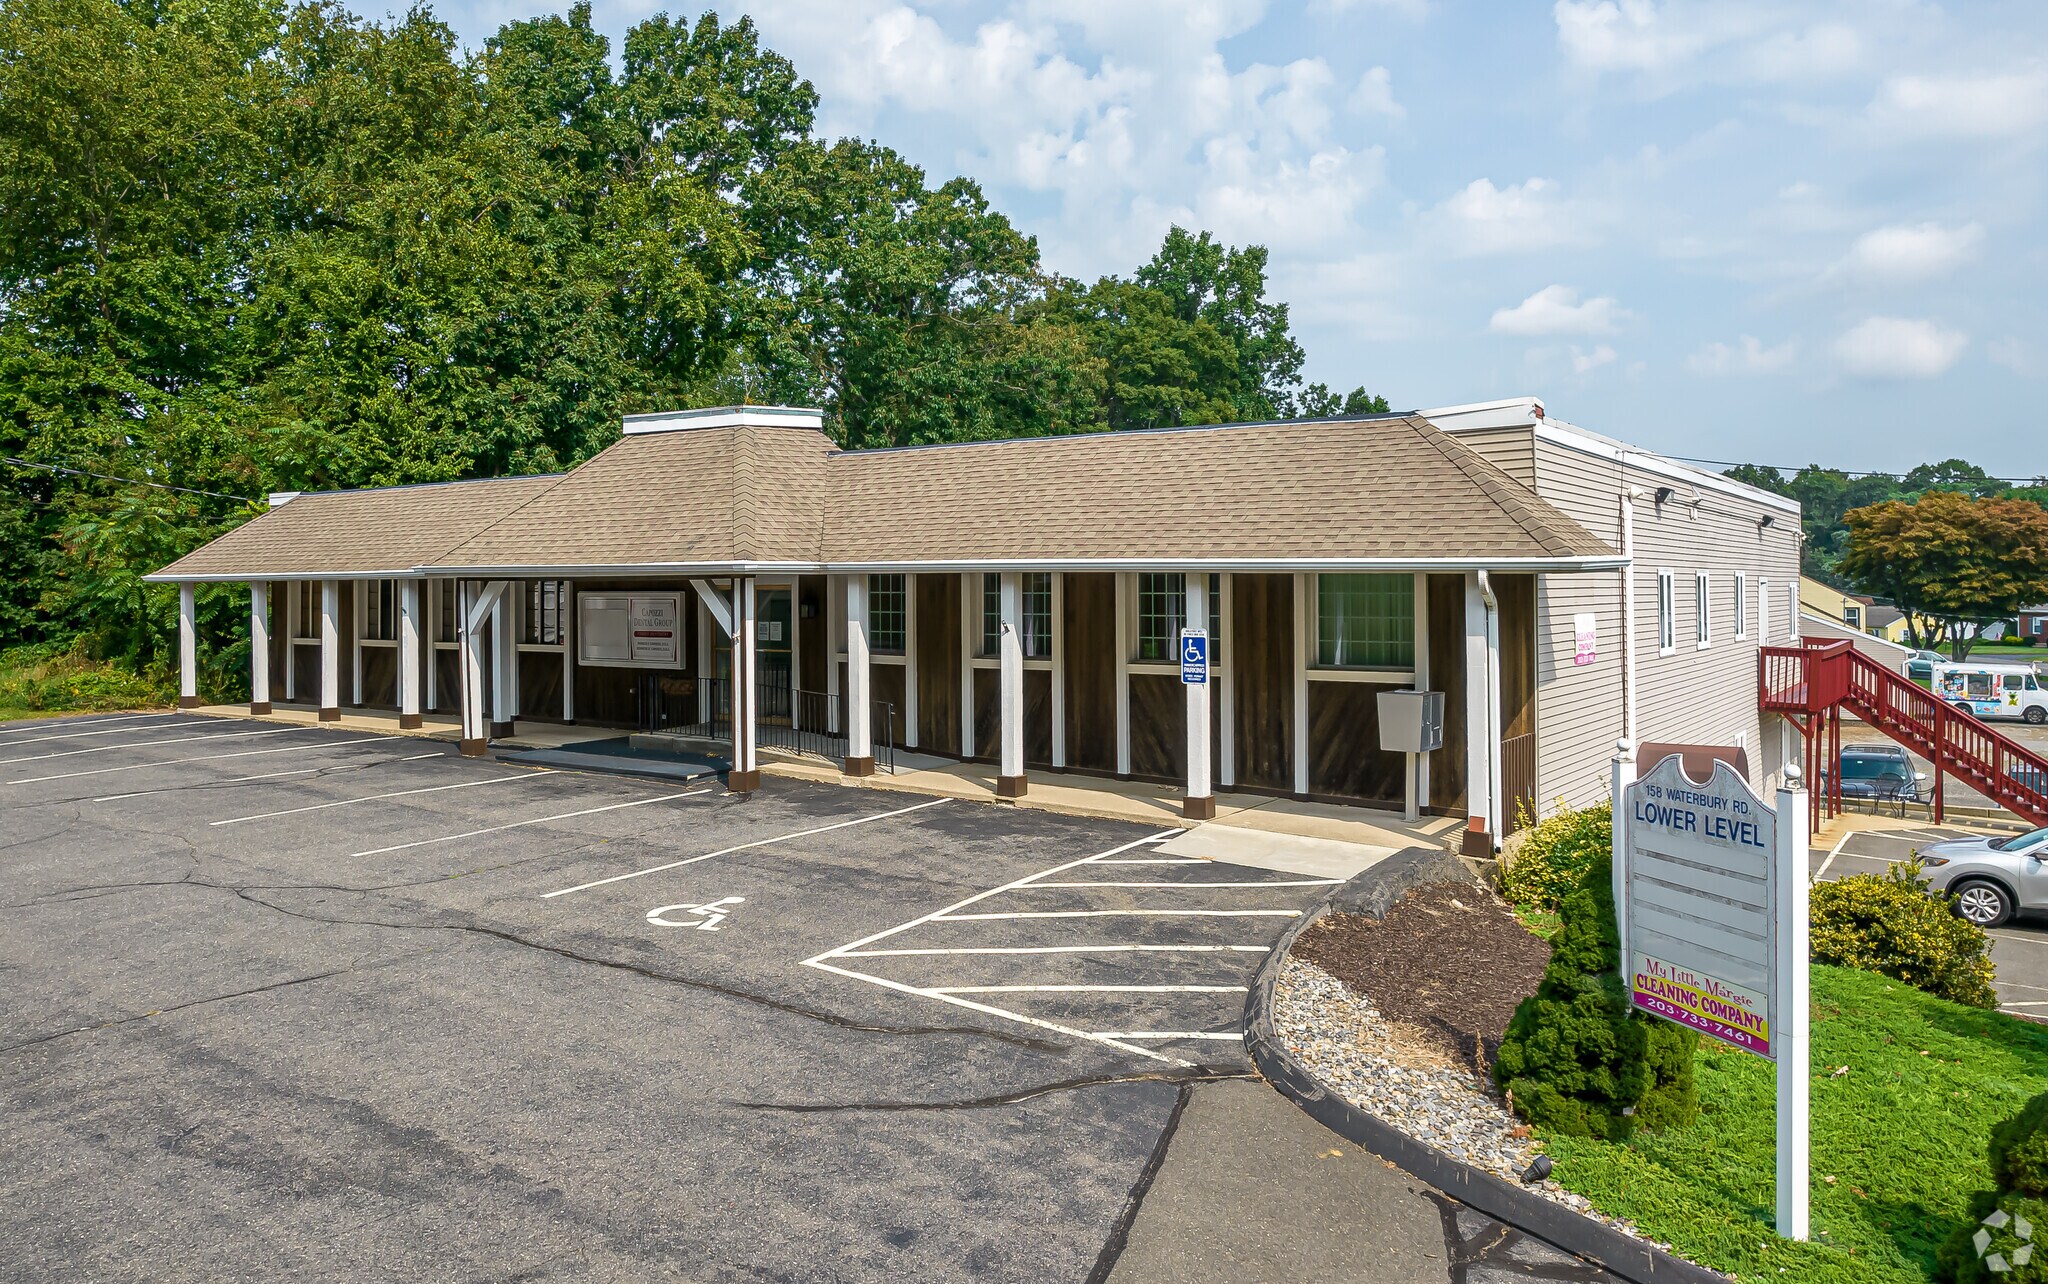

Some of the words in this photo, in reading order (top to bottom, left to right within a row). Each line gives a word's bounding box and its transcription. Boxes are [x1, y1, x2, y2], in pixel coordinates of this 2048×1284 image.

[633, 618, 653, 627] DENTAL
[654, 618, 673, 627] GROUP
[1645, 785, 1663, 799] 158
[1666, 788, 1728, 811] WATERBURY
[1732, 800, 1752, 815] RD.
[1635, 801, 1697, 832] LOWER
[1705, 815, 1765, 848] LEVEL
[1636, 973, 1699, 1009] CLEANING
[1701, 996, 1764, 1033] COMPANY
[1645, 958, 1667, 979] My
[1669, 966, 1700, 989] Little
[1704, 978, 1754, 1008] Margie
